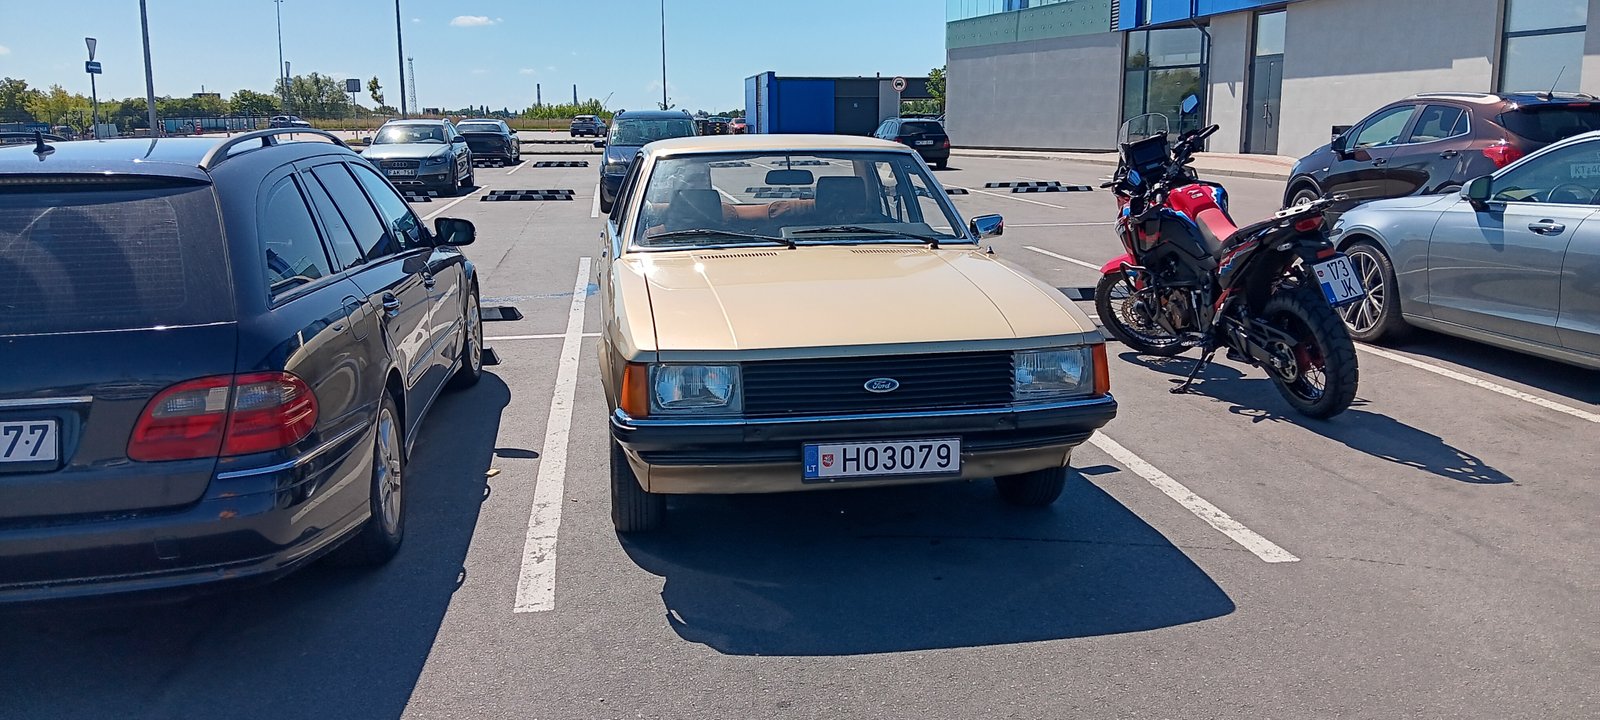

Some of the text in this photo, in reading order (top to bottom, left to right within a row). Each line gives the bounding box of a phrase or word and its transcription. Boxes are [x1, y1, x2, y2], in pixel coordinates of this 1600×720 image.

[1327, 260, 1349, 280] 173
[1341, 277, 1358, 297] JK
[872, 380, 891, 389] Ford
[806, 444, 951, 473] LT H03079
